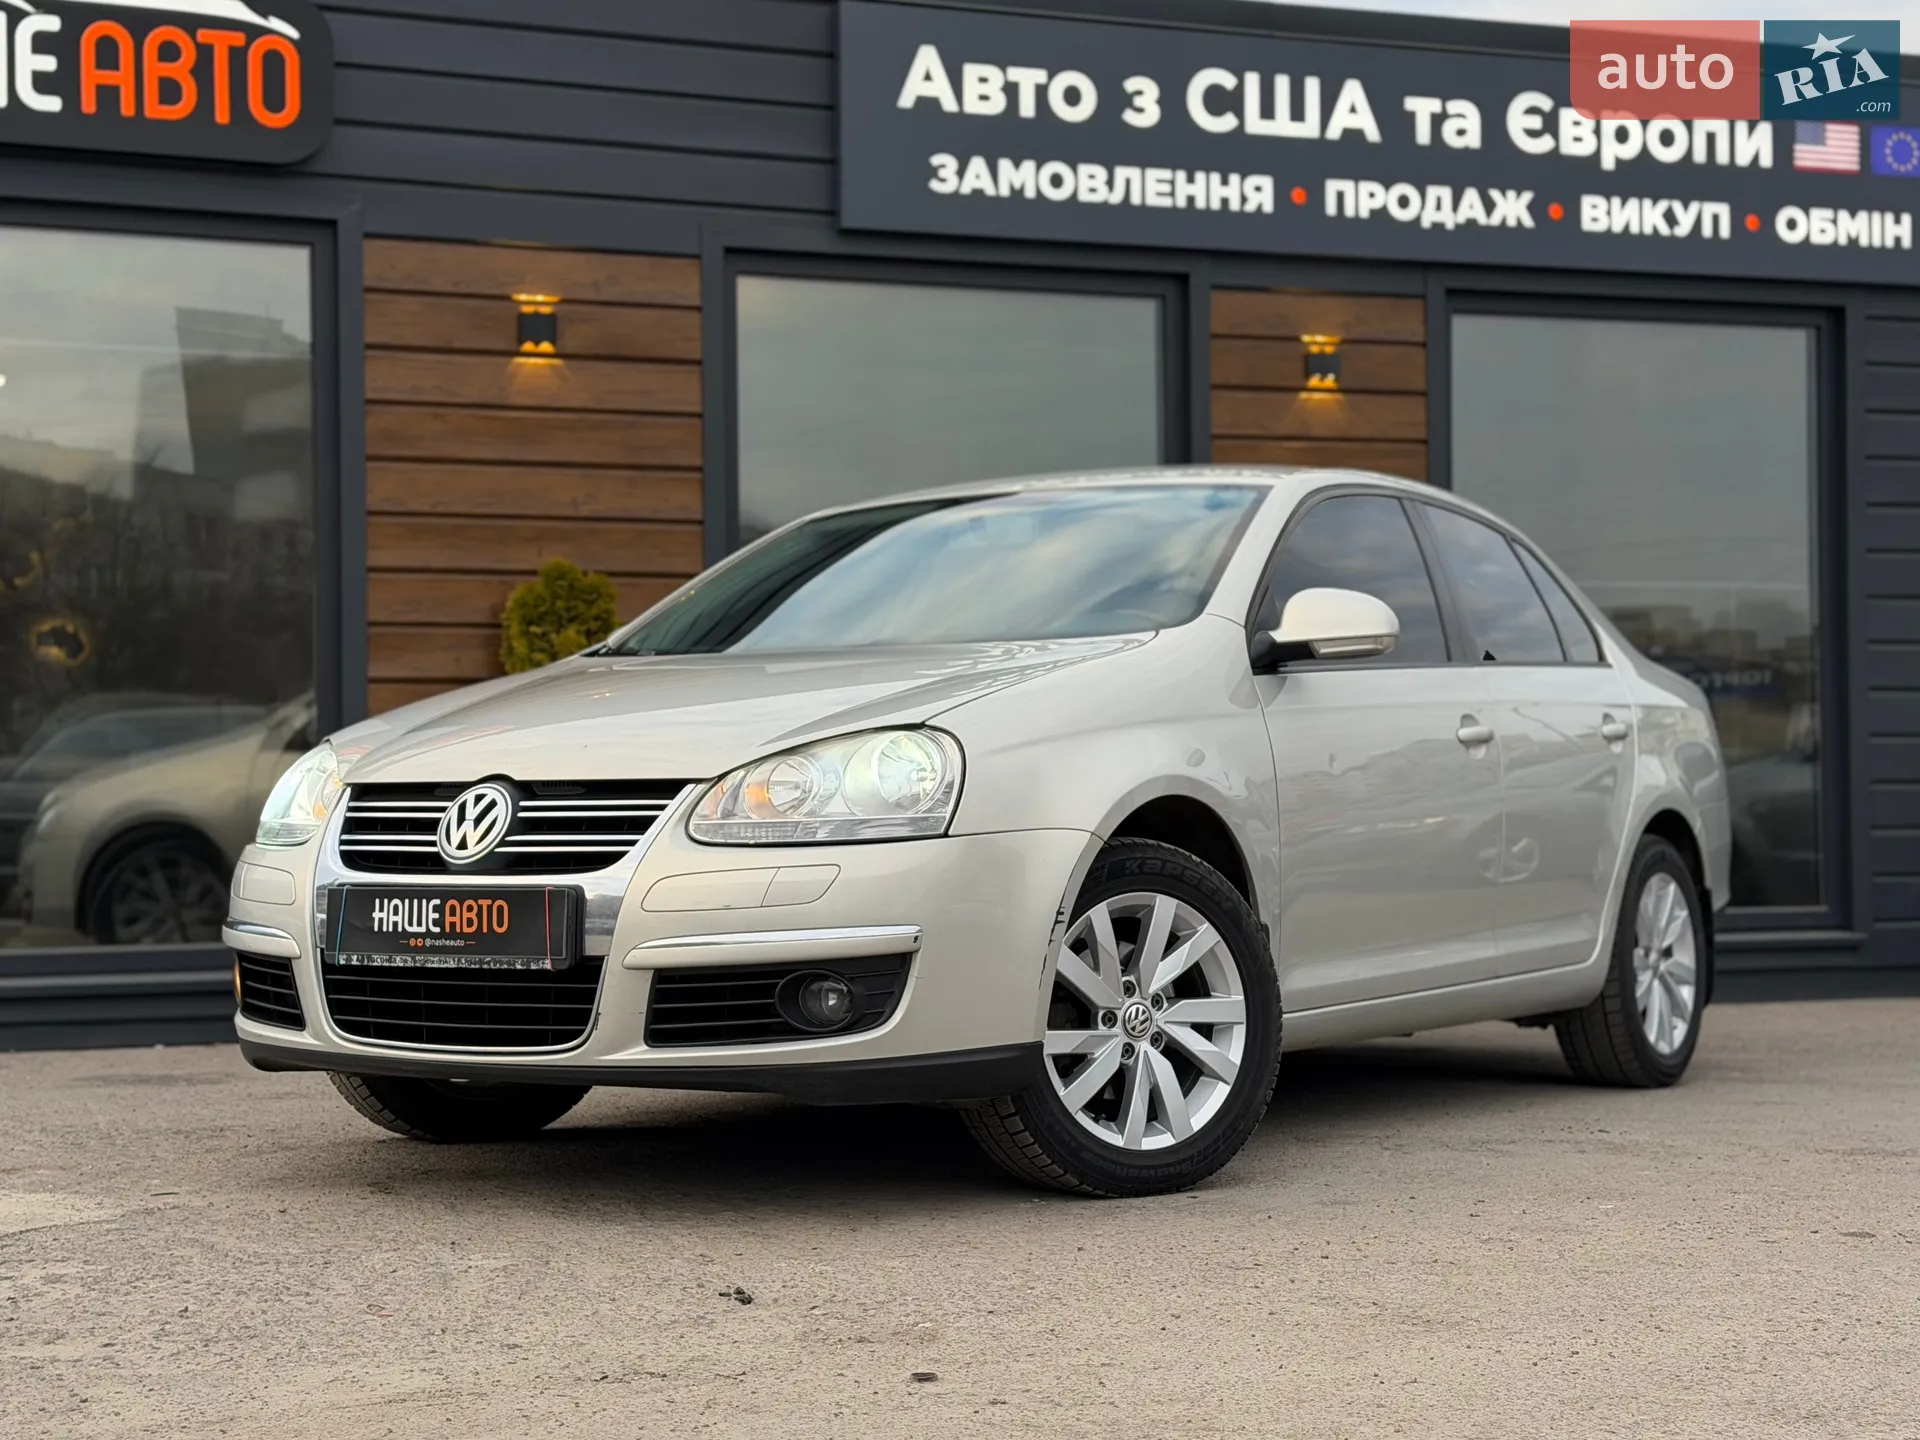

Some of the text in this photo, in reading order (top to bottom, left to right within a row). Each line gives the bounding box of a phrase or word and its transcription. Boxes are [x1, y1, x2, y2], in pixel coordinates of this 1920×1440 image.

[79, 20, 301, 129] АВТО
[897, 44, 1098, 123] Авто
[1186, 68, 1381, 143] США
[1403, 95, 1482, 149] та
[1506, 91, 1774, 171] Європи
[928, 153, 1912, 249] ЗАМОВЛЕННЯ ПРОДАЖ ВИКУП ОБМІН
[372, 898, 509, 934] НАШЕ АВТО
[424, 937, 465, 947] @nasheauto
